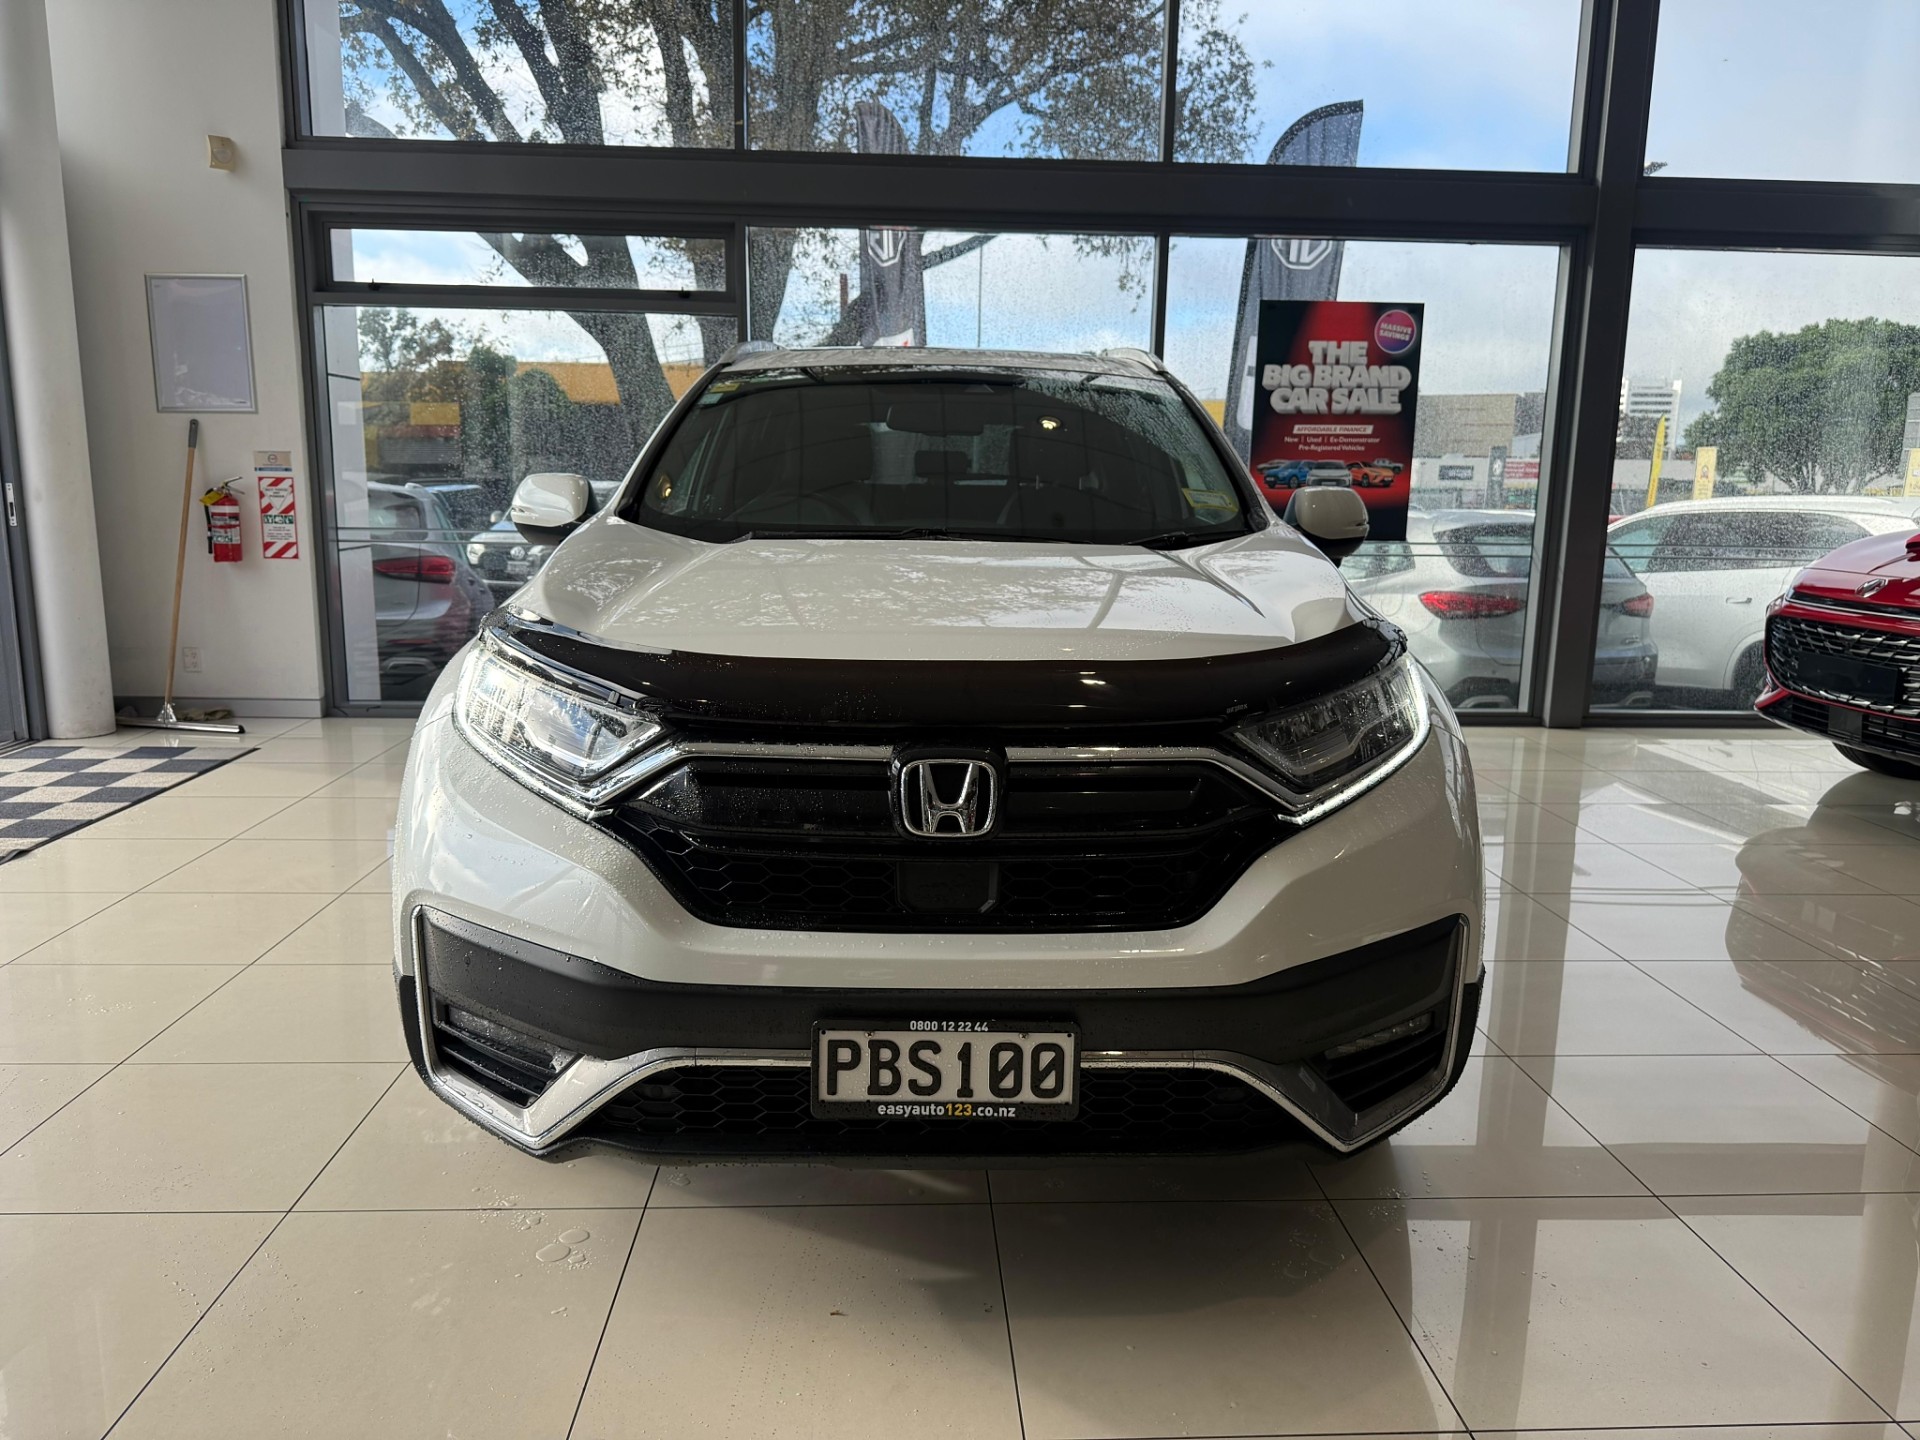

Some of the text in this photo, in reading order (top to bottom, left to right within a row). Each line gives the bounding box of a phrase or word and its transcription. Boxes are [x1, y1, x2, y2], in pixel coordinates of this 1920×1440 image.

[1379, 329, 1410, 342] SAVINGS
[1380, 322, 1412, 335] MASSIVE
[1308, 340, 1369, 365] THE
[1262, 364, 1412, 392] BIG BRAND
[1270, 387, 1402, 415] CAR SALE
[909, 1020, 989, 1032] 0800 12 22 44
[826, 1039, 1065, 1099] PBS100
[877, 1103, 1016, 1118] easyauto123.co.nz
